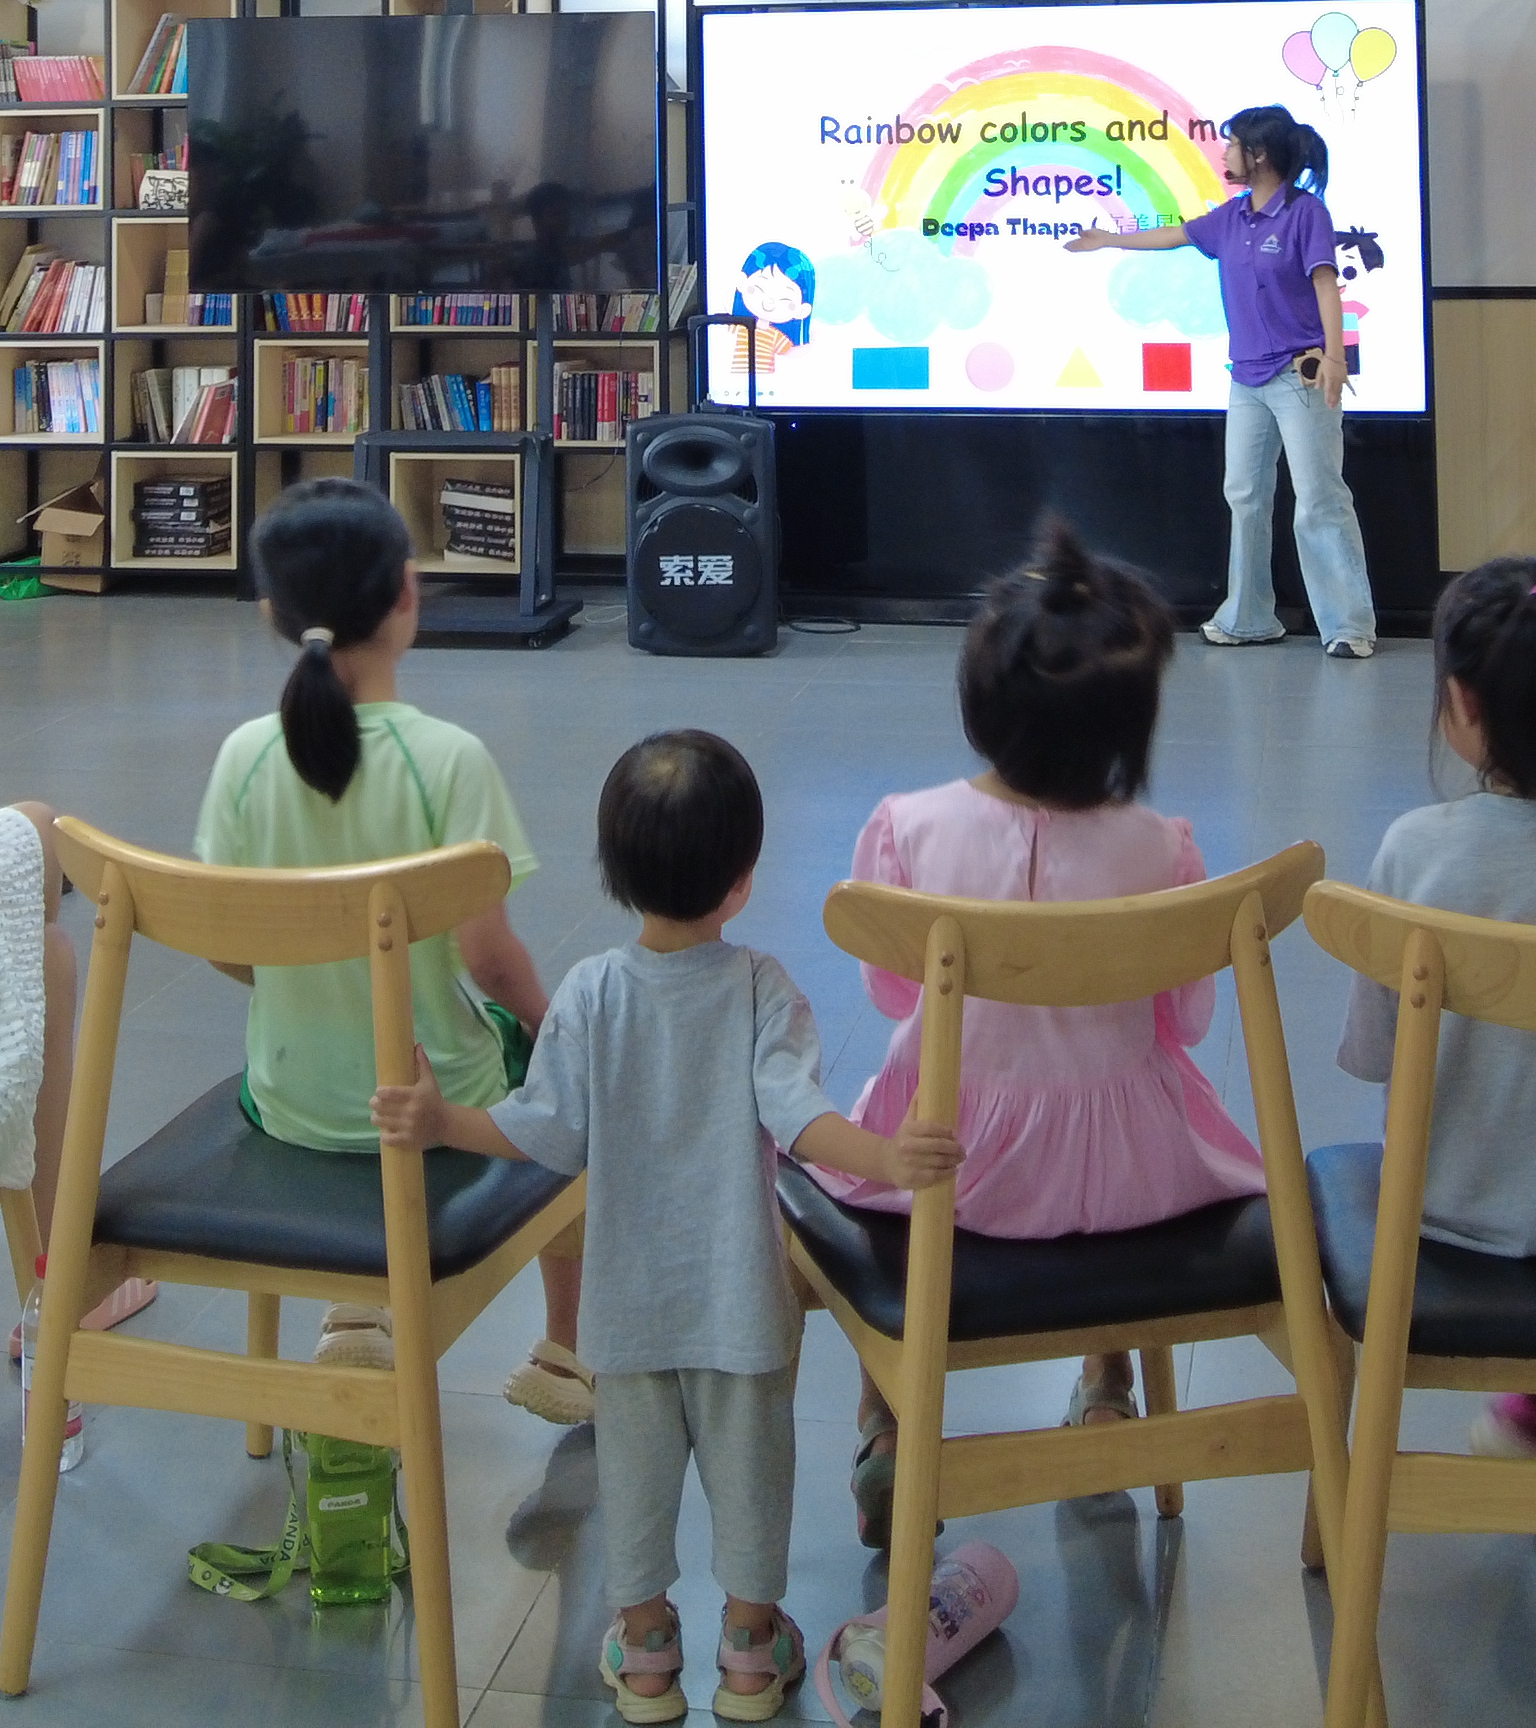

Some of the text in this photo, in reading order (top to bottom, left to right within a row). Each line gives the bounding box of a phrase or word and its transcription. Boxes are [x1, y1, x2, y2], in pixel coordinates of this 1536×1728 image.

[819, 114, 962, 145] Rainbow
[979, 111, 1087, 144] colors
[1105, 110, 1168, 142] and
[982, 164, 1123, 204] Shapes!
[922, 217, 1000, 241] Deepa
[1006, 217, 1084, 241] Thapa
[659, 554, 735, 587] 索爱
